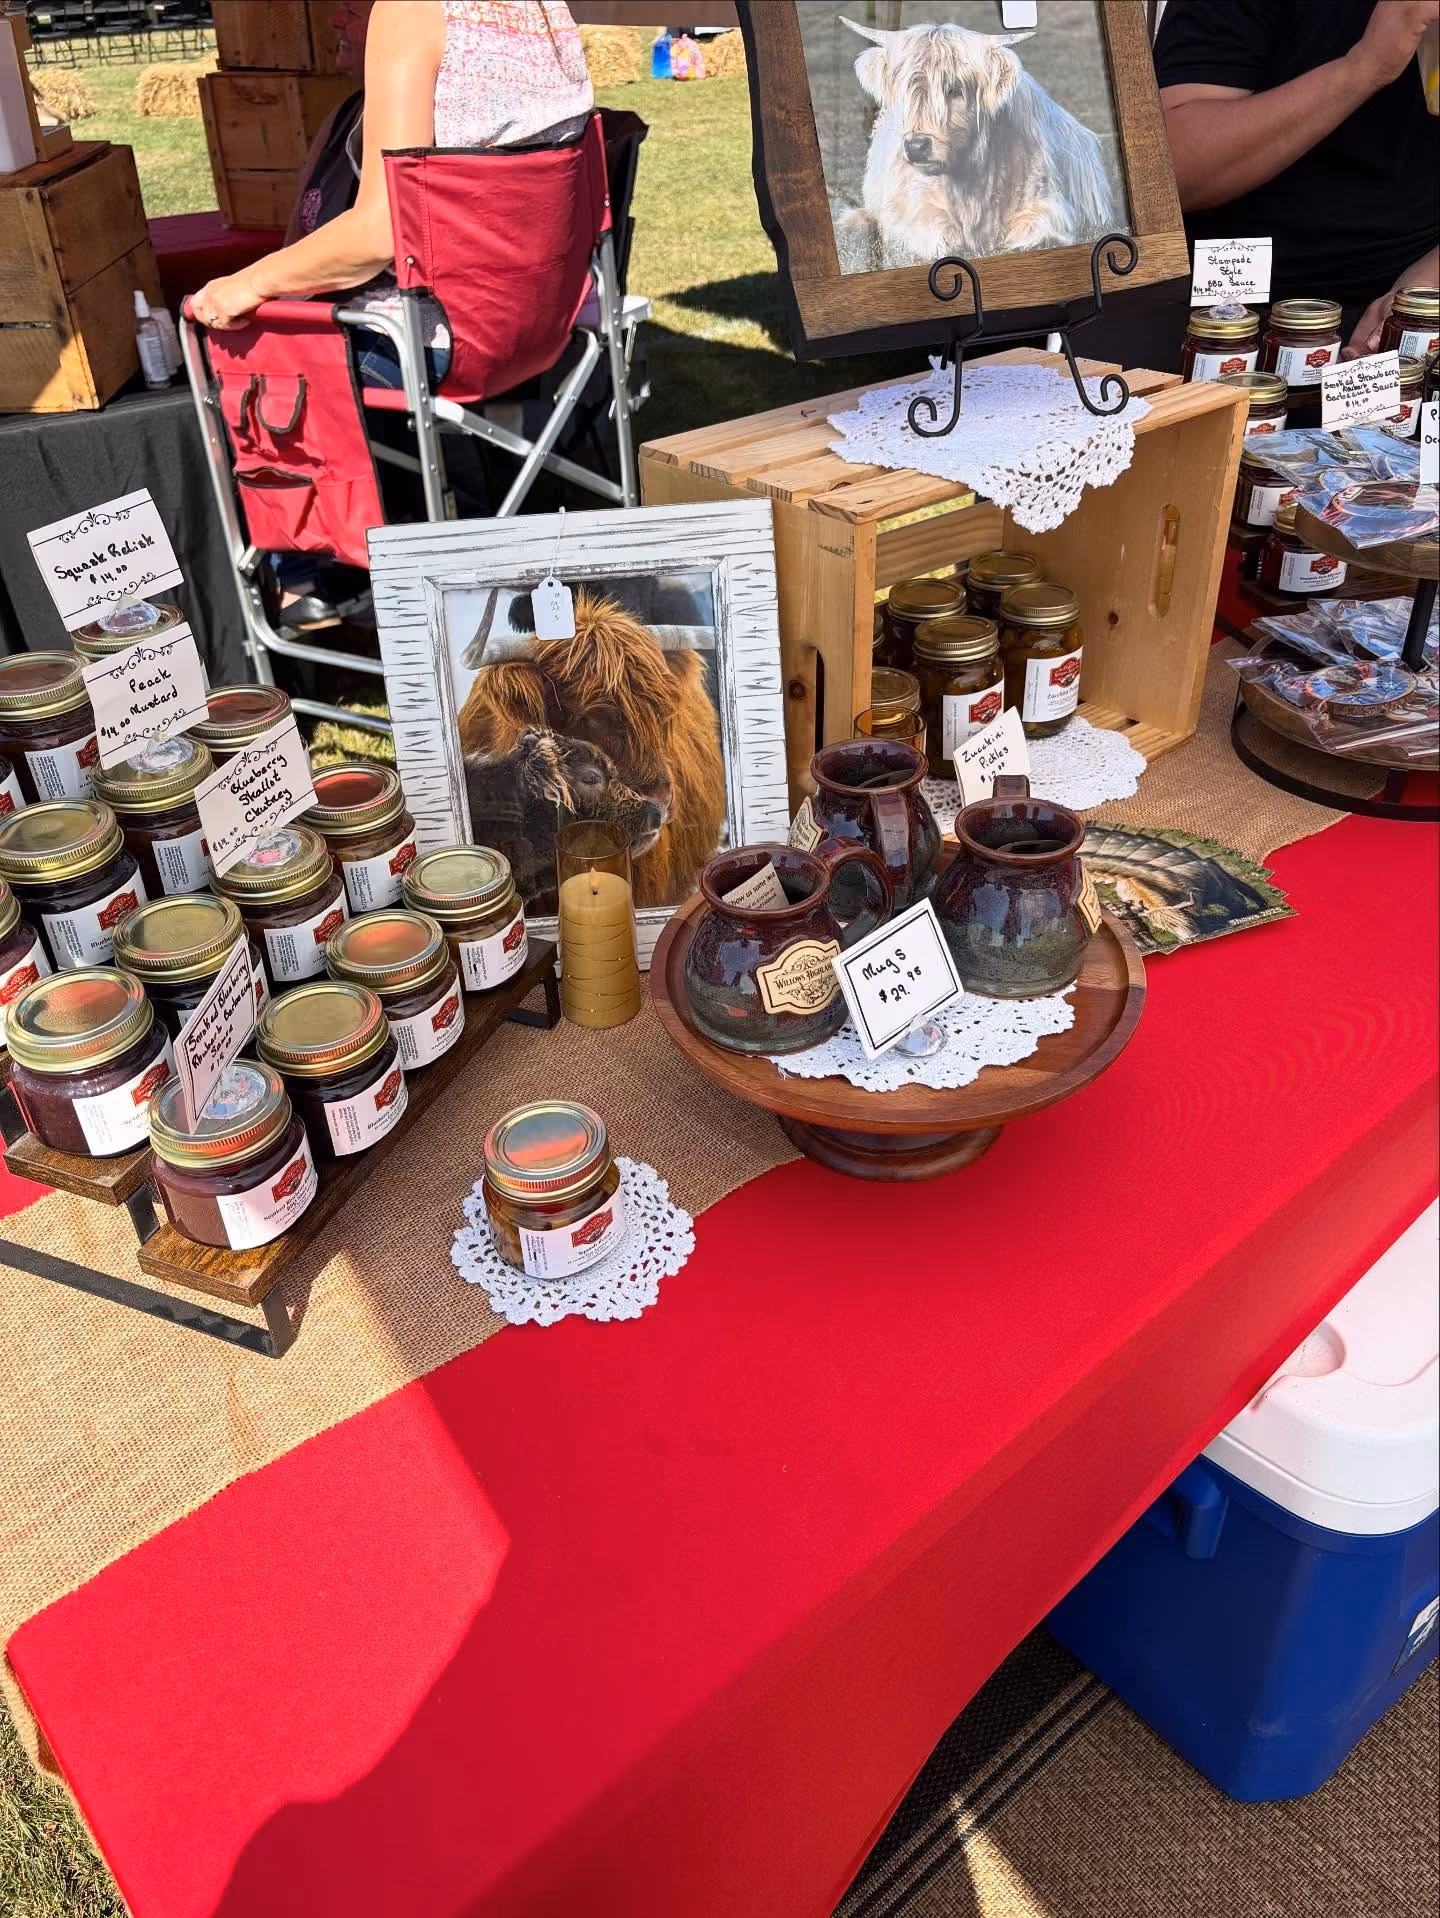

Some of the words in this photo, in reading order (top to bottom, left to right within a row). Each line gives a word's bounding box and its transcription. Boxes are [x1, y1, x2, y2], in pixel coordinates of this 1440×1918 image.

[1207, 280, 1223, 288] BBQ
[1229, 279, 1256, 287] Sauce
[1220, 265, 1243, 281] Style
[1323, 376, 1354, 390] Smoked
[1357, 369, 1400, 382] Strawberry
[1372, 381, 1399, 393] Sauce
[54, 551, 107, 582] Squash
[107, 533, 155, 557] Relish
[129, 668, 171, 693] Peach
[130, 684, 178, 715] Mustard
[962, 726, 1004, 763] Zucchini
[978, 746, 1009, 769] Pickles
[231, 755, 287, 794] Blueberry
[239, 769, 281, 806] Shallot
[245, 788, 292, 823] Chutney
[729, 895, 745, 906] how
[1260, 907, 1282, 917] 2025
[188, 1003, 219, 1052] Smoked
[218, 963, 249, 1009] Blueberry
[192, 1025, 222, 1069] Rhubarb
[211, 1024, 234, 1058] Sauce
